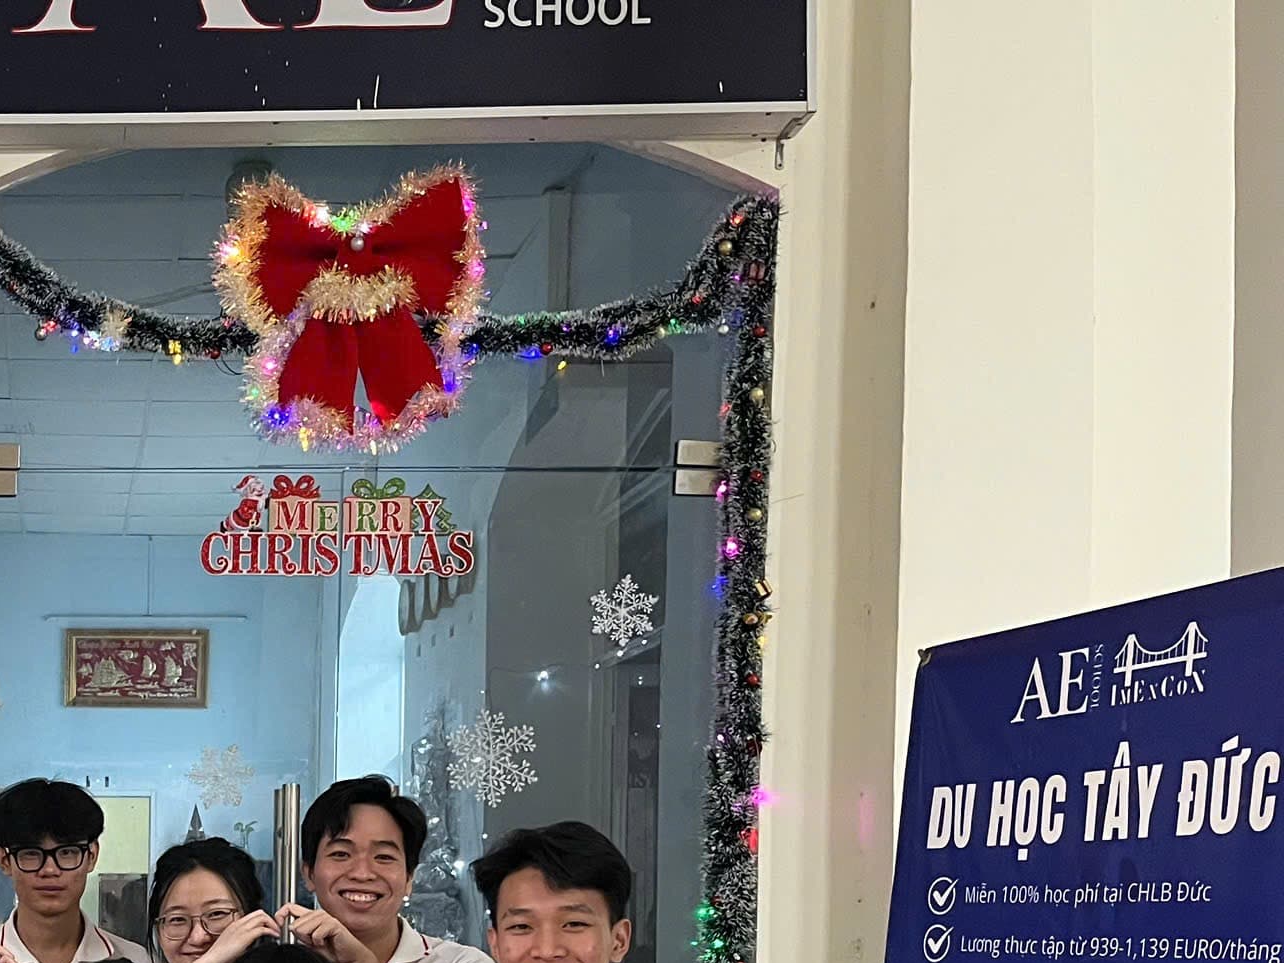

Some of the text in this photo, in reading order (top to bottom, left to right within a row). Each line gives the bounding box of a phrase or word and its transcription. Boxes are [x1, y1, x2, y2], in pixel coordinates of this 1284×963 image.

[484, 0, 651, 28] SCHOOL
[273, 498, 440, 533] MERRY
[199, 531, 475, 577] CHRISTMAS
[1010, 647, 1090, 723] AE
[926, 735, 1282, 861] DU HỌC TÂY ĐỨC
[965, 880, 1212, 908] Miễn 100% học phí tại CHLB Đức
[960, 935, 1001, 959] Lương
[1005, 935, 1038, 958] thực
[1041, 936, 1065, 960] tập
[1069, 936, 1088, 957] từ
[1090, 936, 1170, 960] 939-1,139
